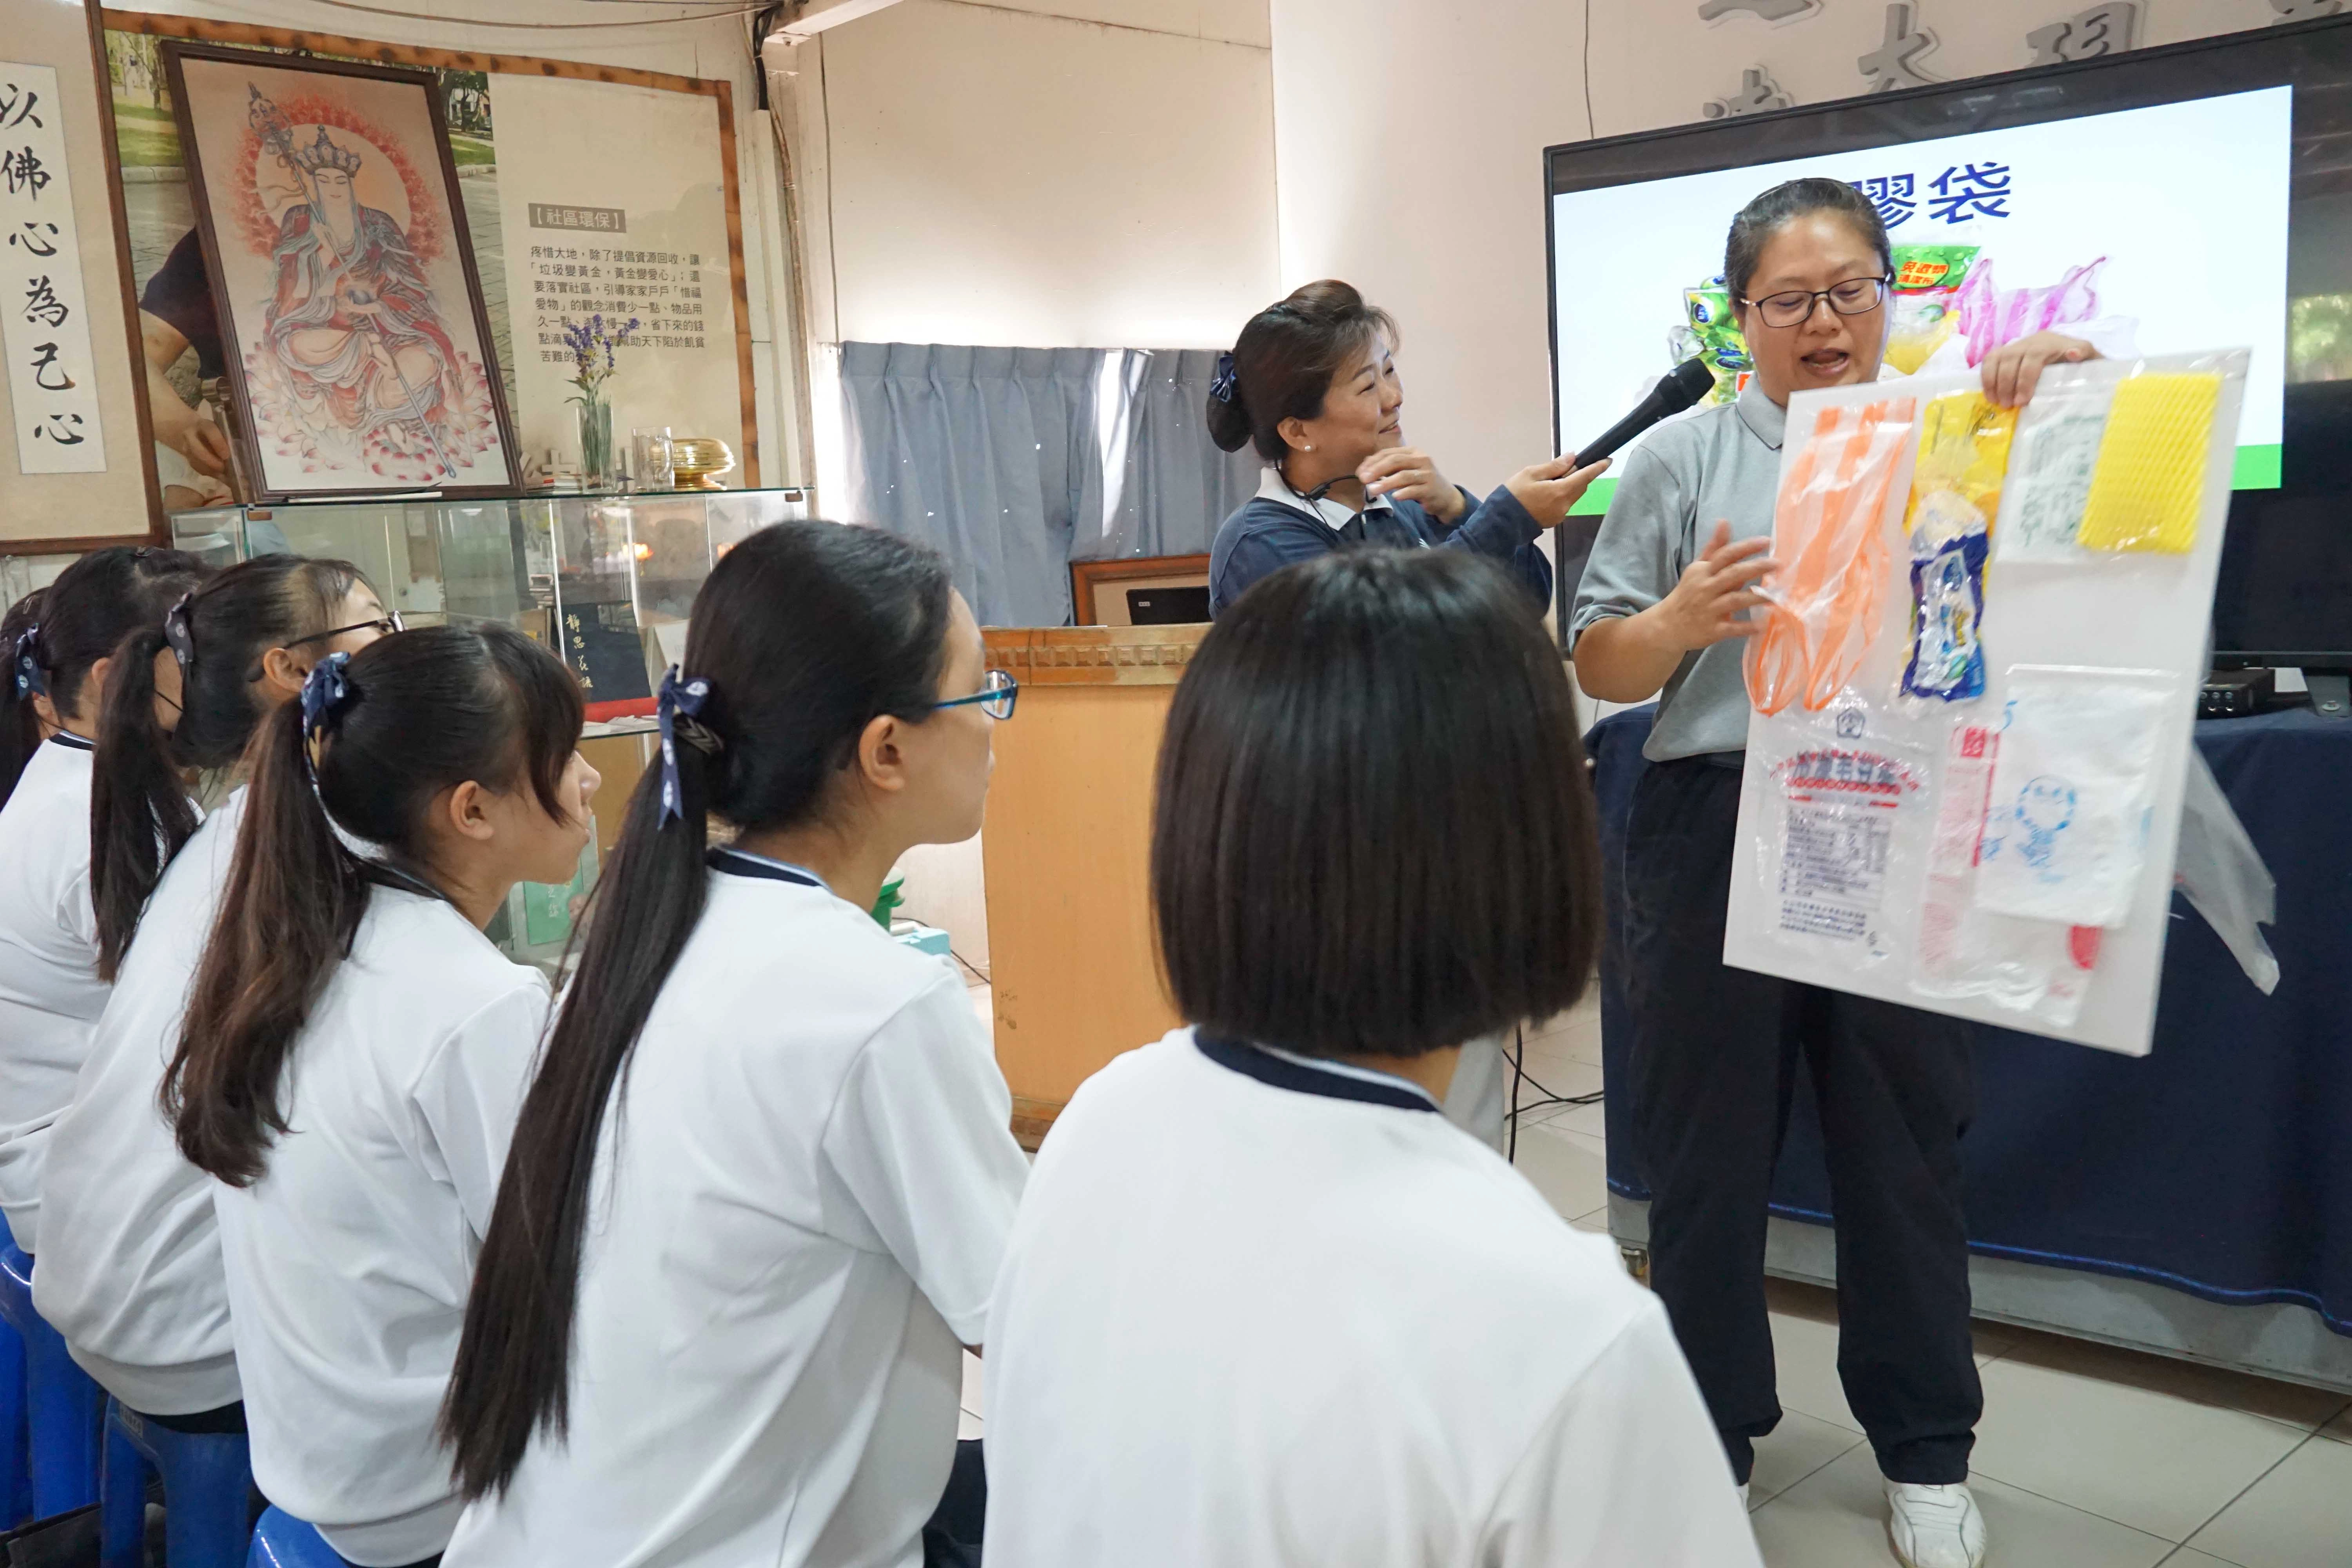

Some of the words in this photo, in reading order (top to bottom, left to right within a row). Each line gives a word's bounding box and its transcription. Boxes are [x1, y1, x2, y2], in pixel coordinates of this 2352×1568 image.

[0, 83, 85, 445] 以佛心為己心
[1849, 162, 2011, 230] 膠袋
